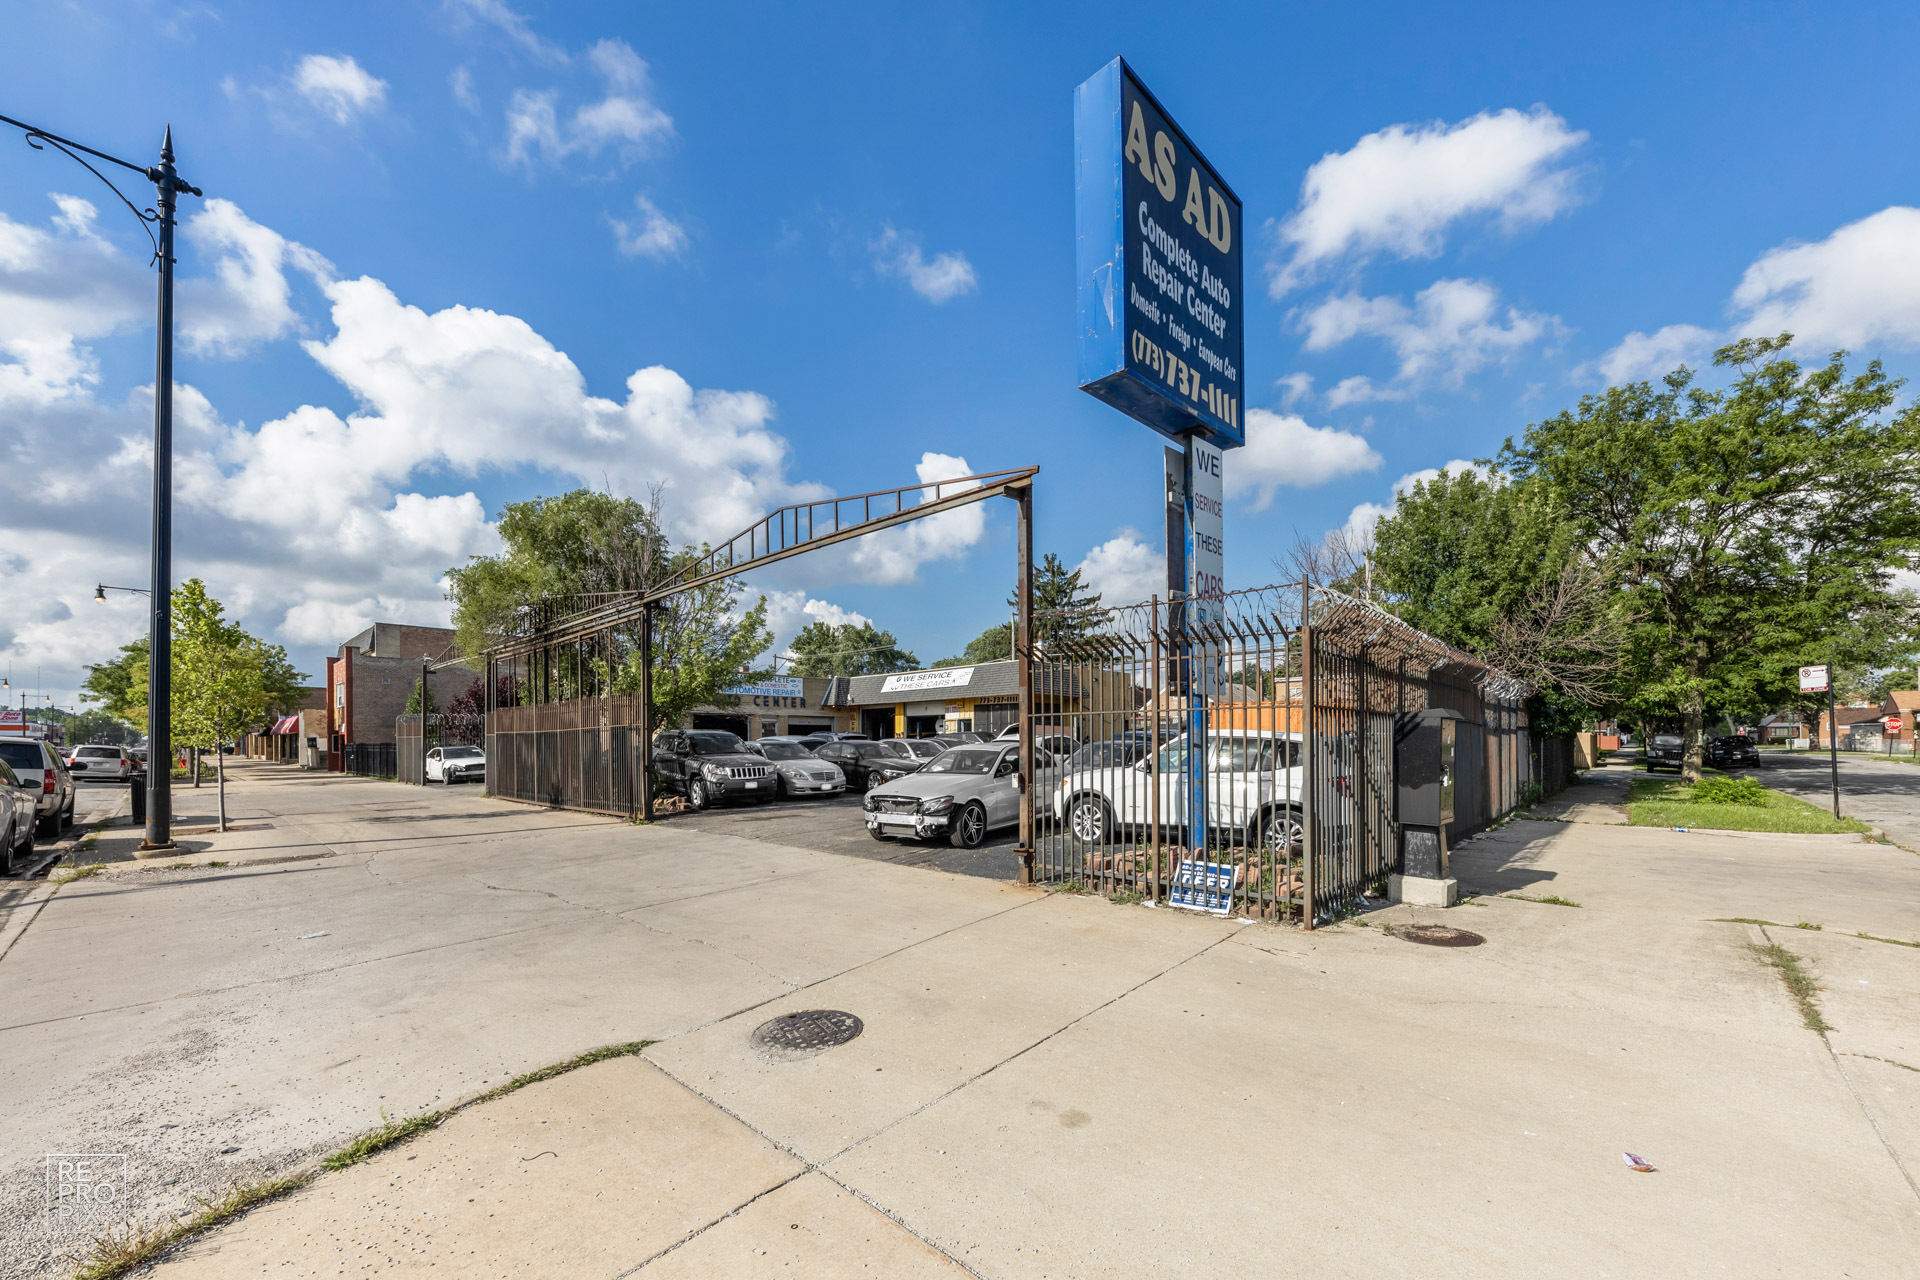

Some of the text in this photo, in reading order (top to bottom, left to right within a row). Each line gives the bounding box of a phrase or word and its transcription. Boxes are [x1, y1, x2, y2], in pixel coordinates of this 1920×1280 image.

[1138, 201, 1231, 310] Complete Auto
[1142, 241, 1226, 340] Repair Center
[1130, 281, 1236, 382] Domestic Foreign European Cars
[1196, 447, 1220, 478] WE
[1194, 492, 1222, 518] SERVICE
[1195, 531, 1223, 557] THESE
[1195, 570, 1223, 604] CARS
[899, 679, 950, 690] THESE CARS
[917, 671, 953, 681] SERVICE
[754, 695, 806, 708] CENTER
